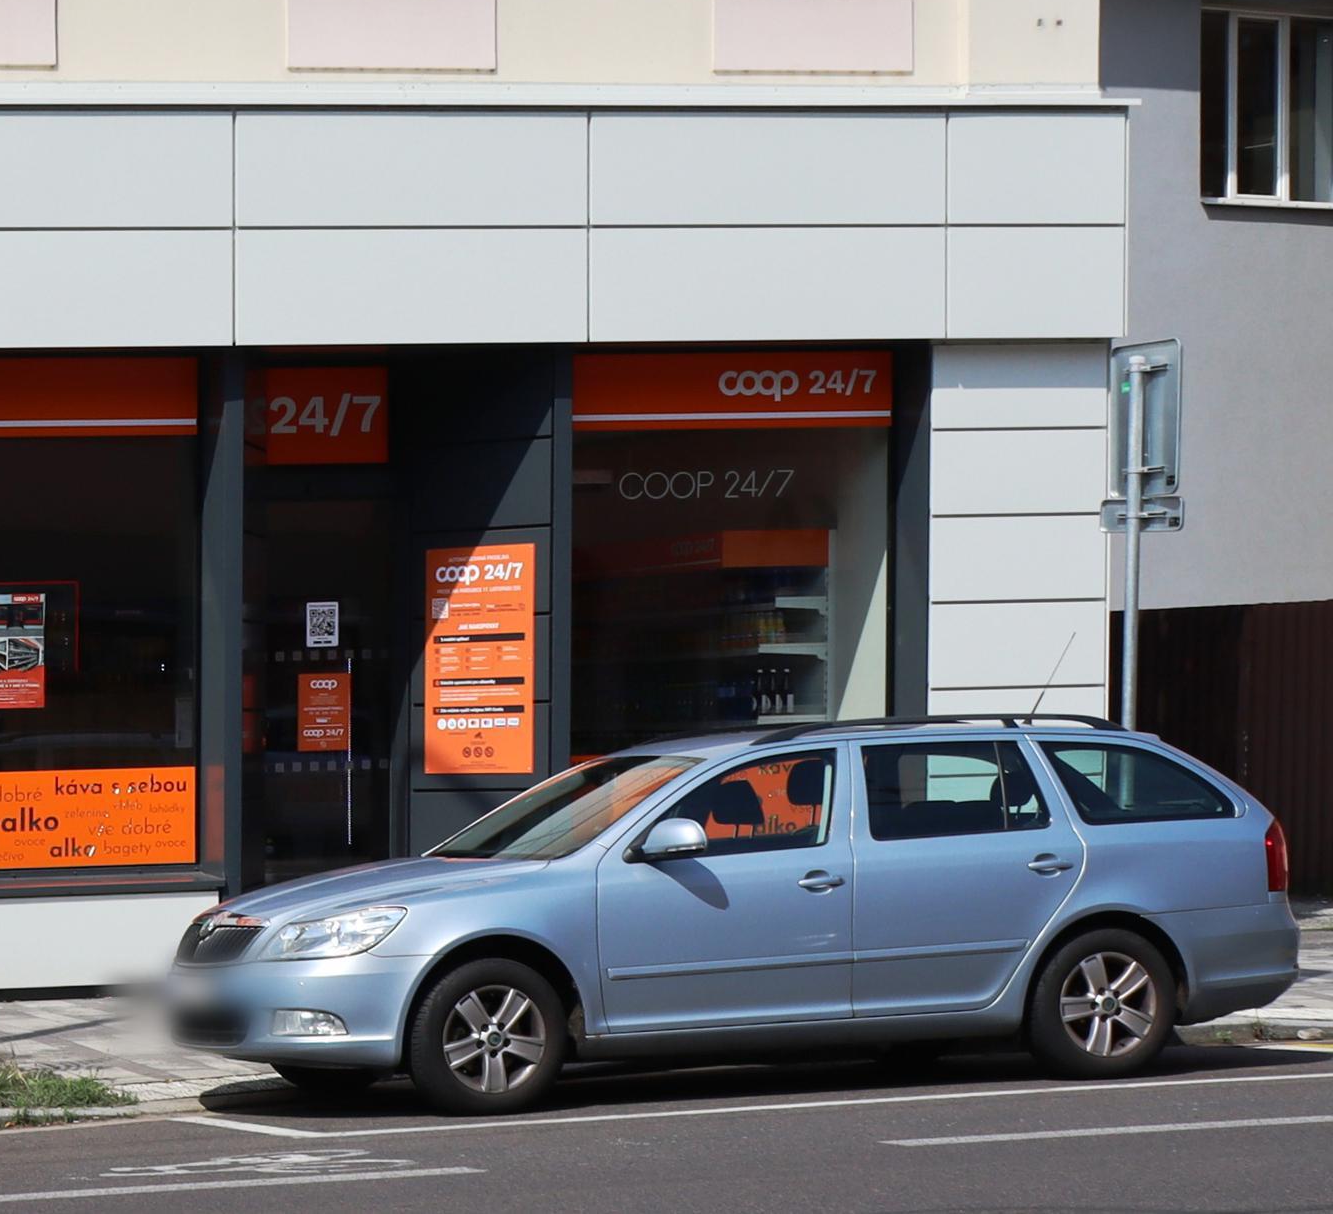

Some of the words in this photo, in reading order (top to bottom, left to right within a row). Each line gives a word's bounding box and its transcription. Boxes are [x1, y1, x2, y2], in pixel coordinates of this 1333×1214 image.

[718, 370, 799, 402] coop
[808, 369, 877, 396] 24/7
[269, 393, 381, 436] 24/7
[619, 471, 715, 500] COOP
[724, 470, 795, 498] 24/7
[436, 565, 480, 586] coop
[484, 562, 523, 580] 24/7
[55, 776, 102, 796] káva
[127, 773, 187, 793] sebou
[121, 817, 172, 836] dobré
[50, 837, 96, 858] alko
[103, 840, 152, 857] bagety
